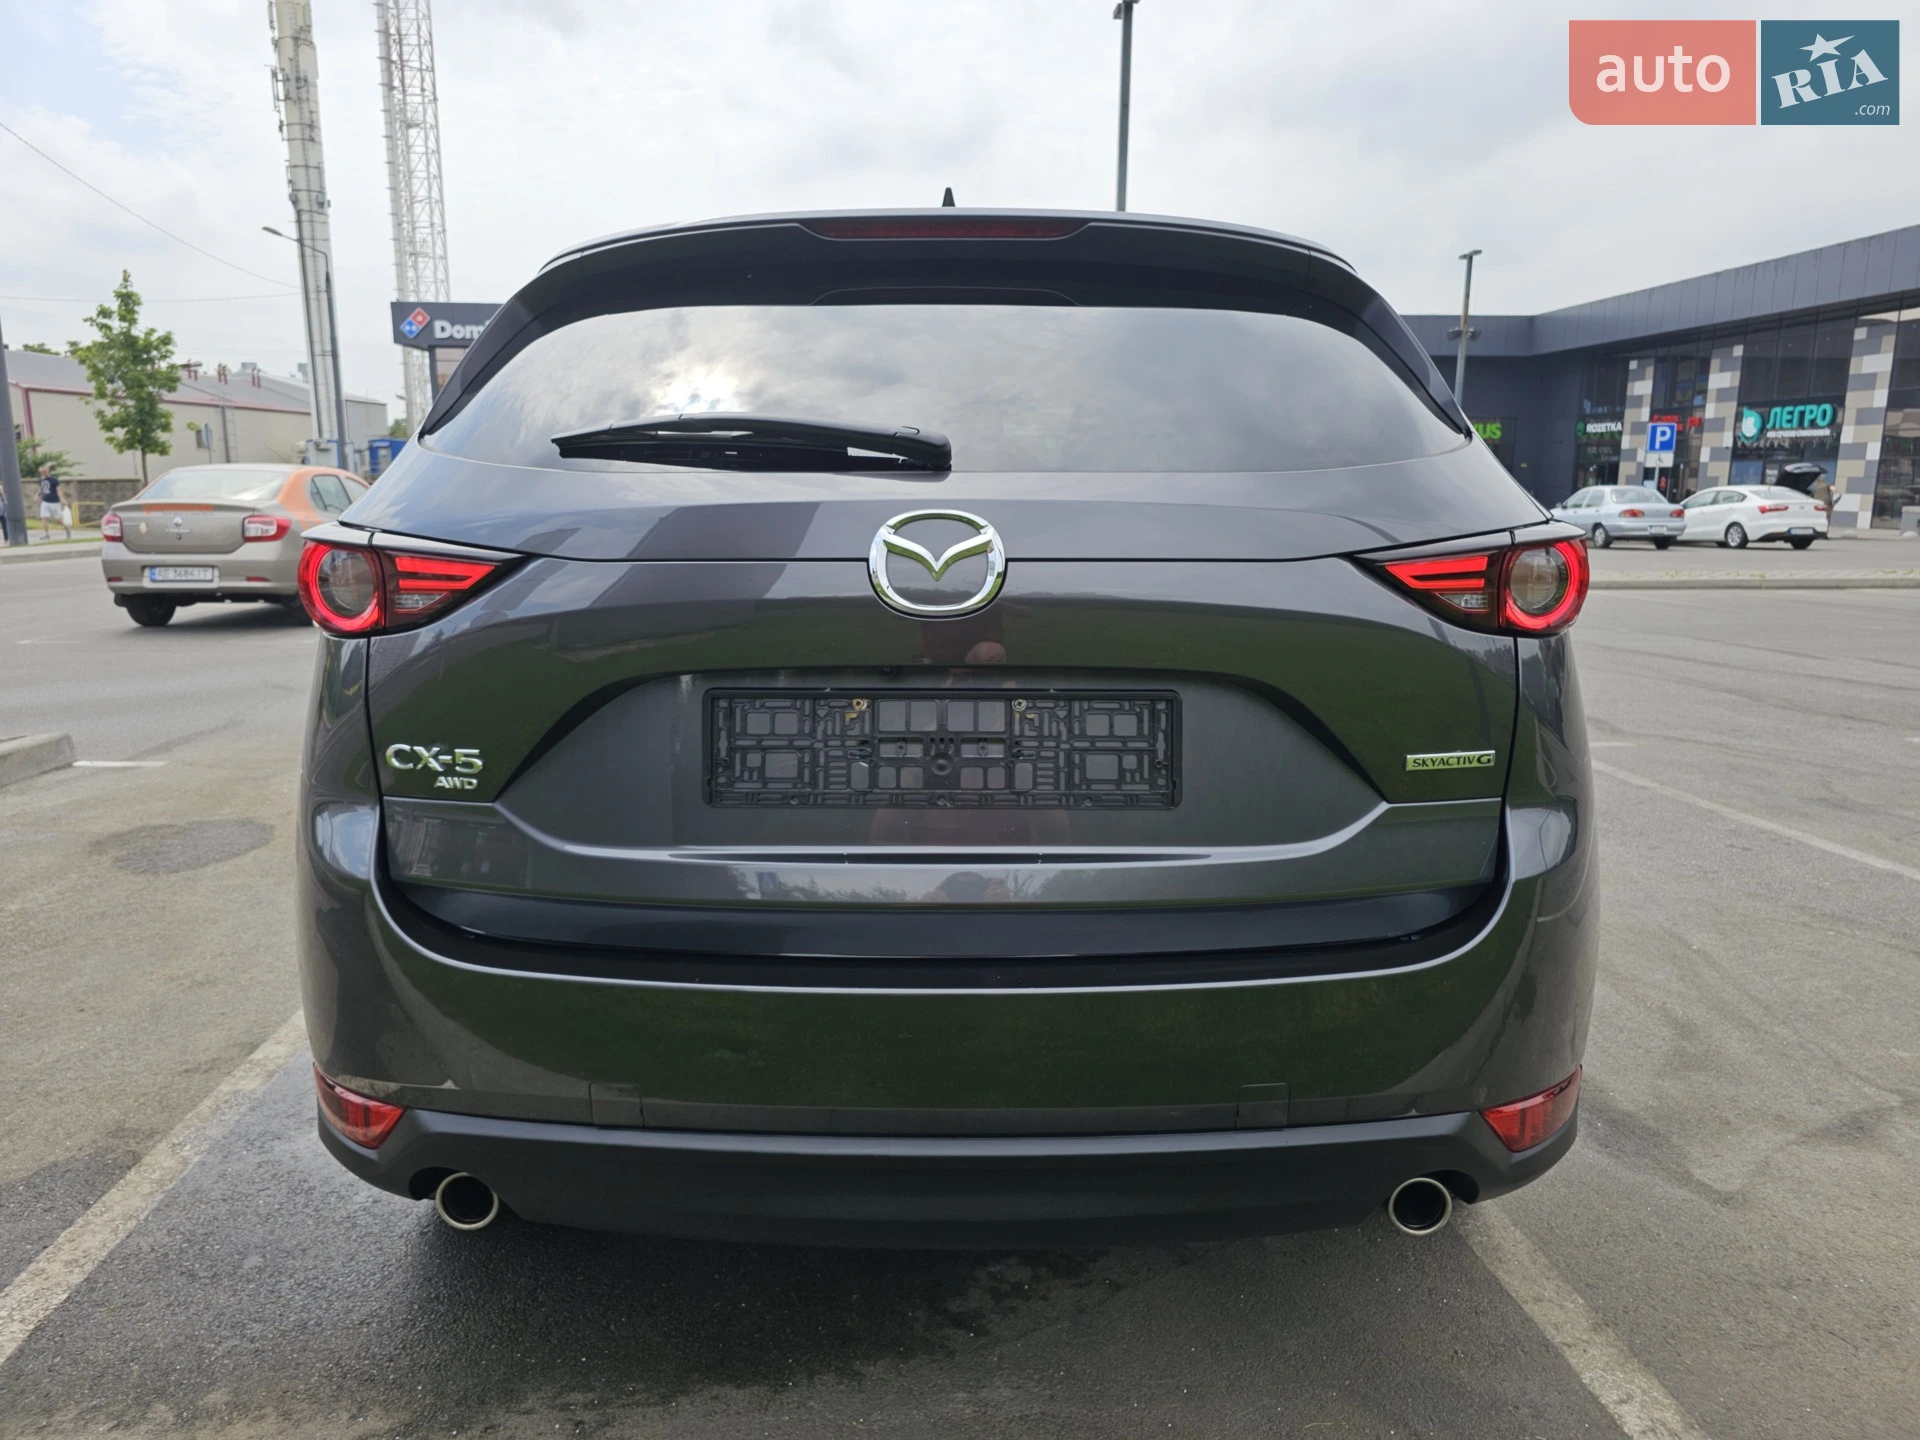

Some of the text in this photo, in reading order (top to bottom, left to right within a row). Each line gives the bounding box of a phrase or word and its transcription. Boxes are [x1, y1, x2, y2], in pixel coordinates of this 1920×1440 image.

[434, 320, 489, 339] Dom
[1766, 403, 1833, 429] ЛЕГРО
[1586, 421, 1622, 433] ROZETKA
[1654, 426, 1671, 450] P
[386, 744, 483, 774] CX-5
[434, 776, 478, 790] AWD
